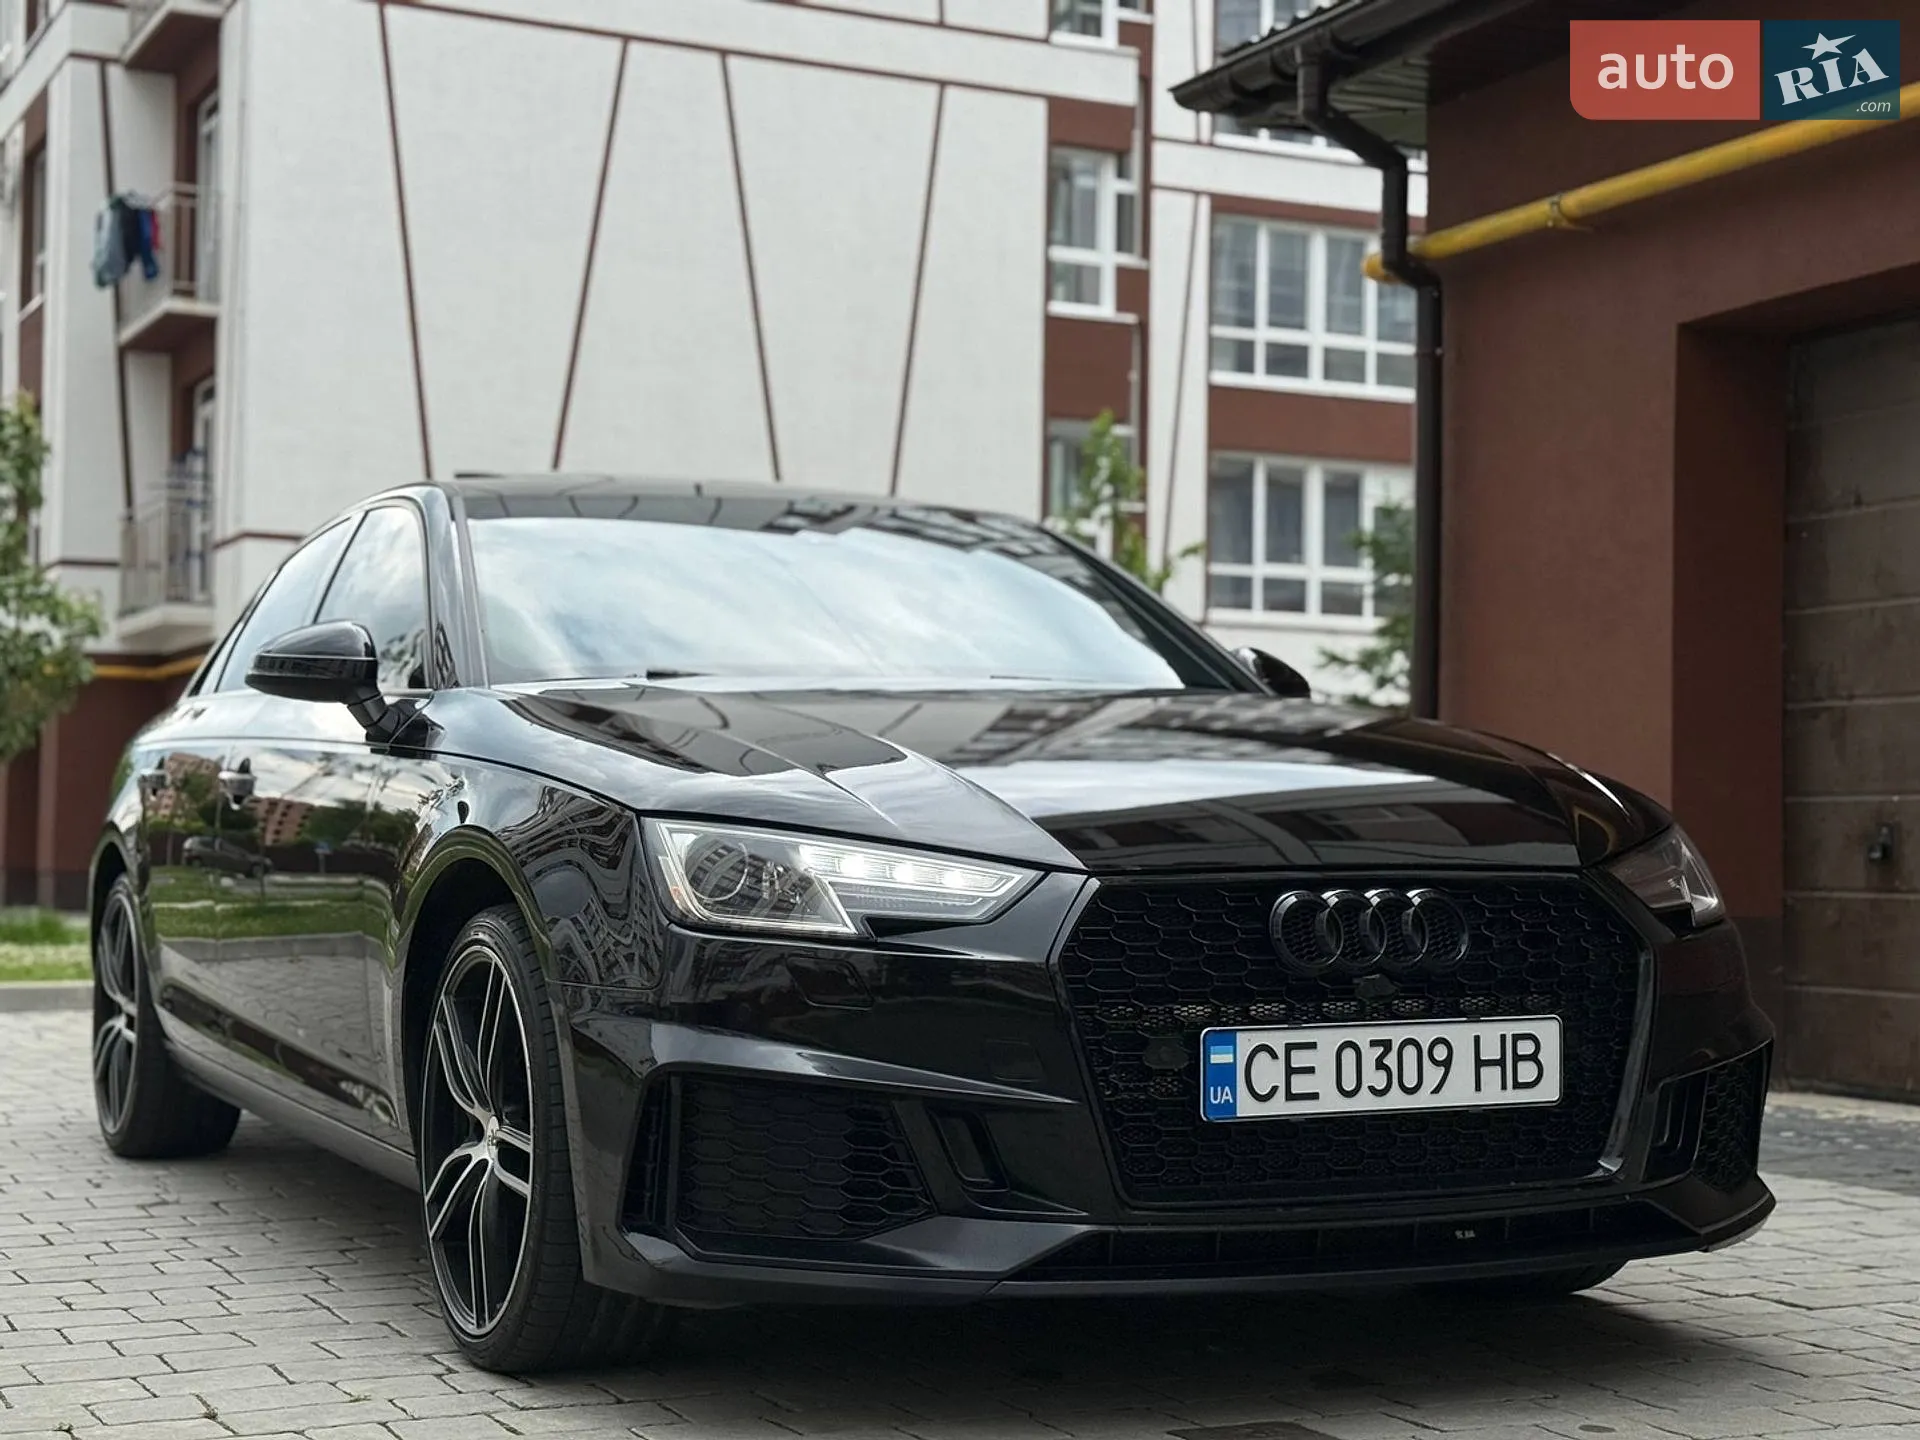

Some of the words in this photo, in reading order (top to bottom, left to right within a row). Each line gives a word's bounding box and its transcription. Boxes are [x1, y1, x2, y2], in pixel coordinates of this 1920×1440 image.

[1244, 1041, 1320, 1102] CE
[1335, 1036, 1454, 1099] 0309
[1473, 1032, 1545, 1092] HB
[1210, 1086, 1233, 1104] UA
